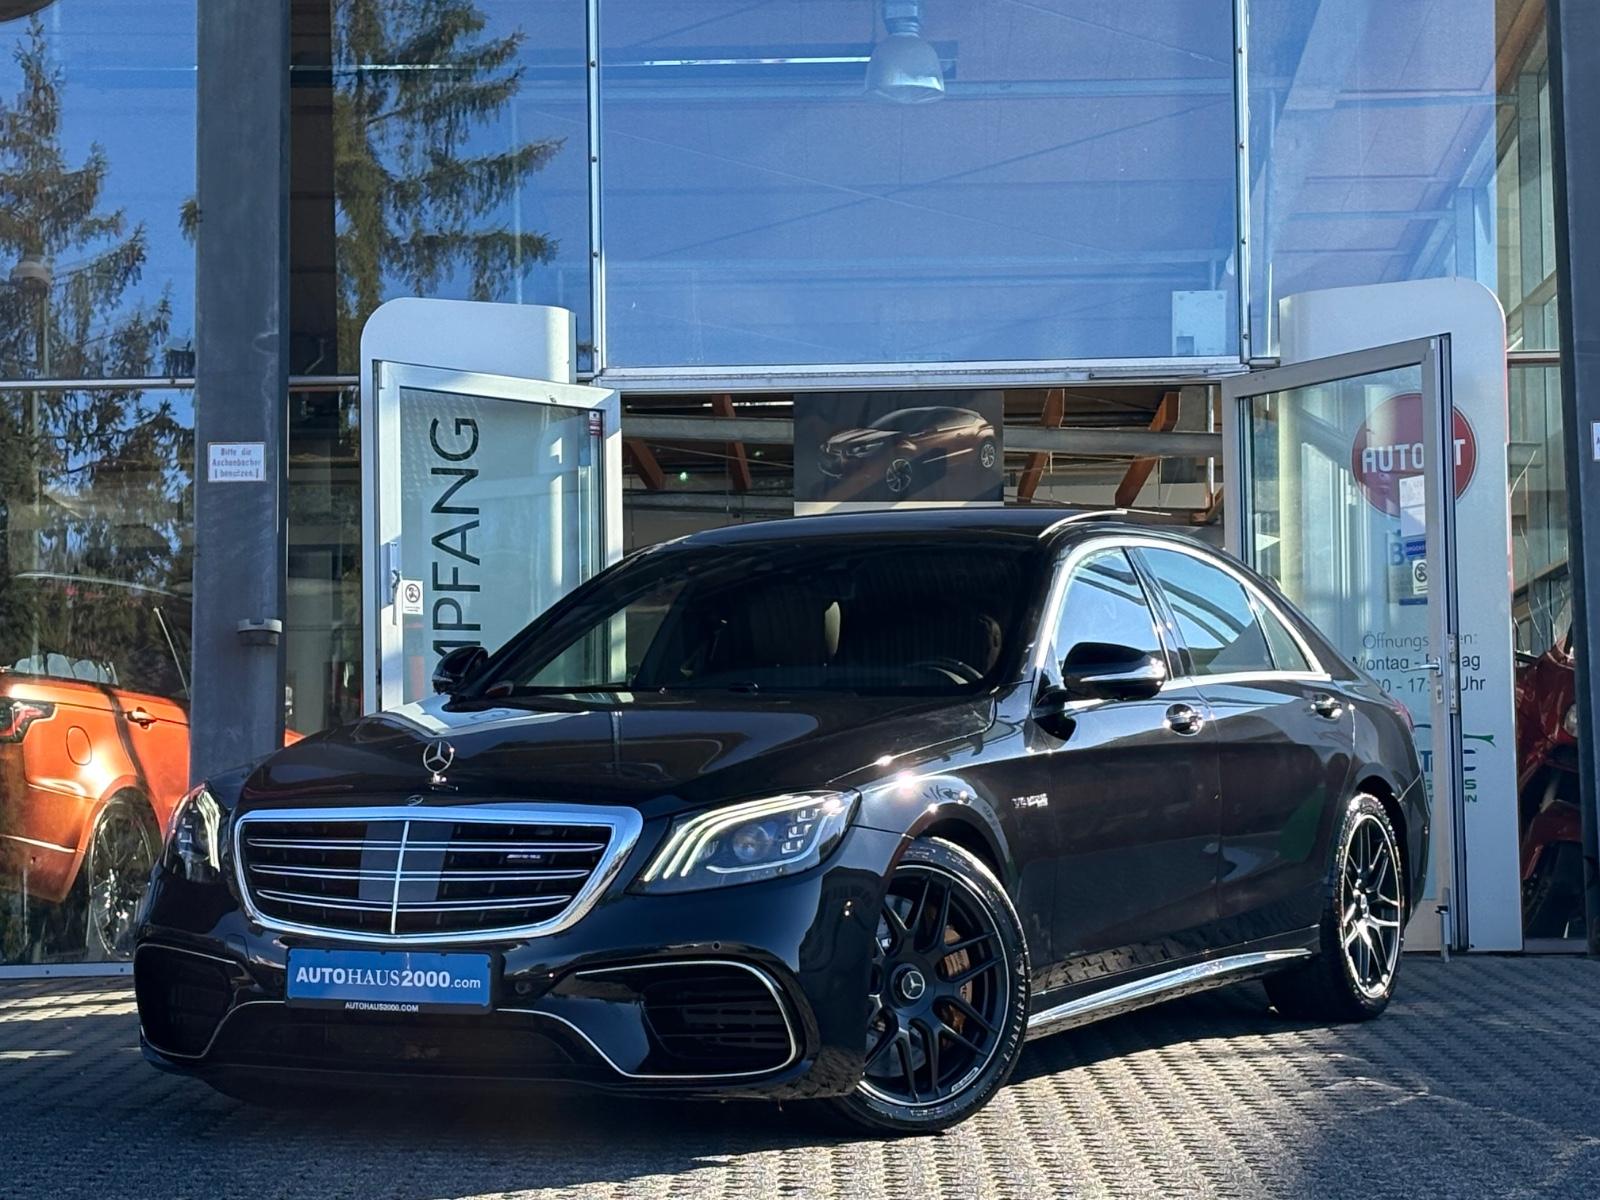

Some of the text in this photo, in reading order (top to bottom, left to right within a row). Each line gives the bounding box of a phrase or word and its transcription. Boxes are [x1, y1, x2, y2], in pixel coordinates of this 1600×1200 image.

[1362, 438, 1466, 473] AUTOT
[430, 418, 481, 657] PFANG
[345, 1002, 419, 1012] AUTOHAUS2000.COM
